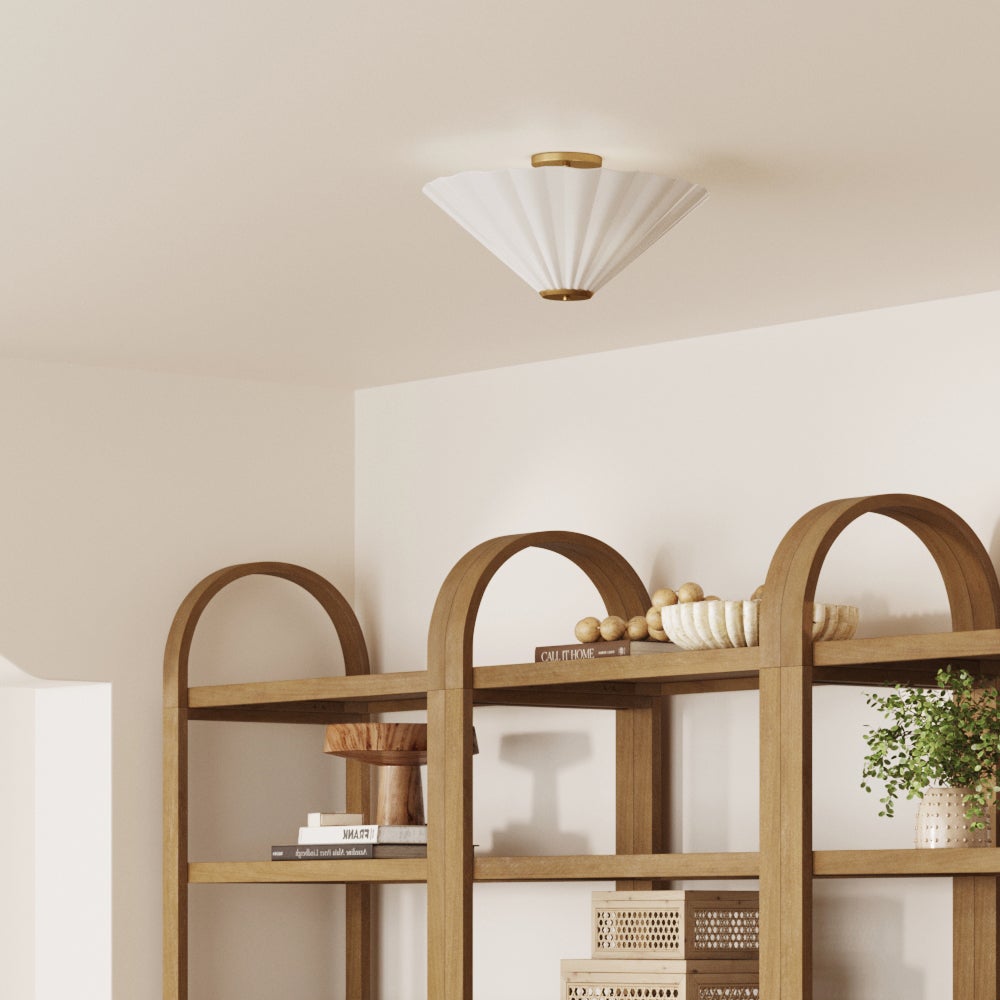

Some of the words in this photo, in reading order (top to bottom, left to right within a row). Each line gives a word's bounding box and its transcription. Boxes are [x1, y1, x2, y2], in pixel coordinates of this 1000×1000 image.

[541, 650, 561, 662] CALL
[562, 650, 570, 660] IT
[570, 648, 594, 660] HOME
